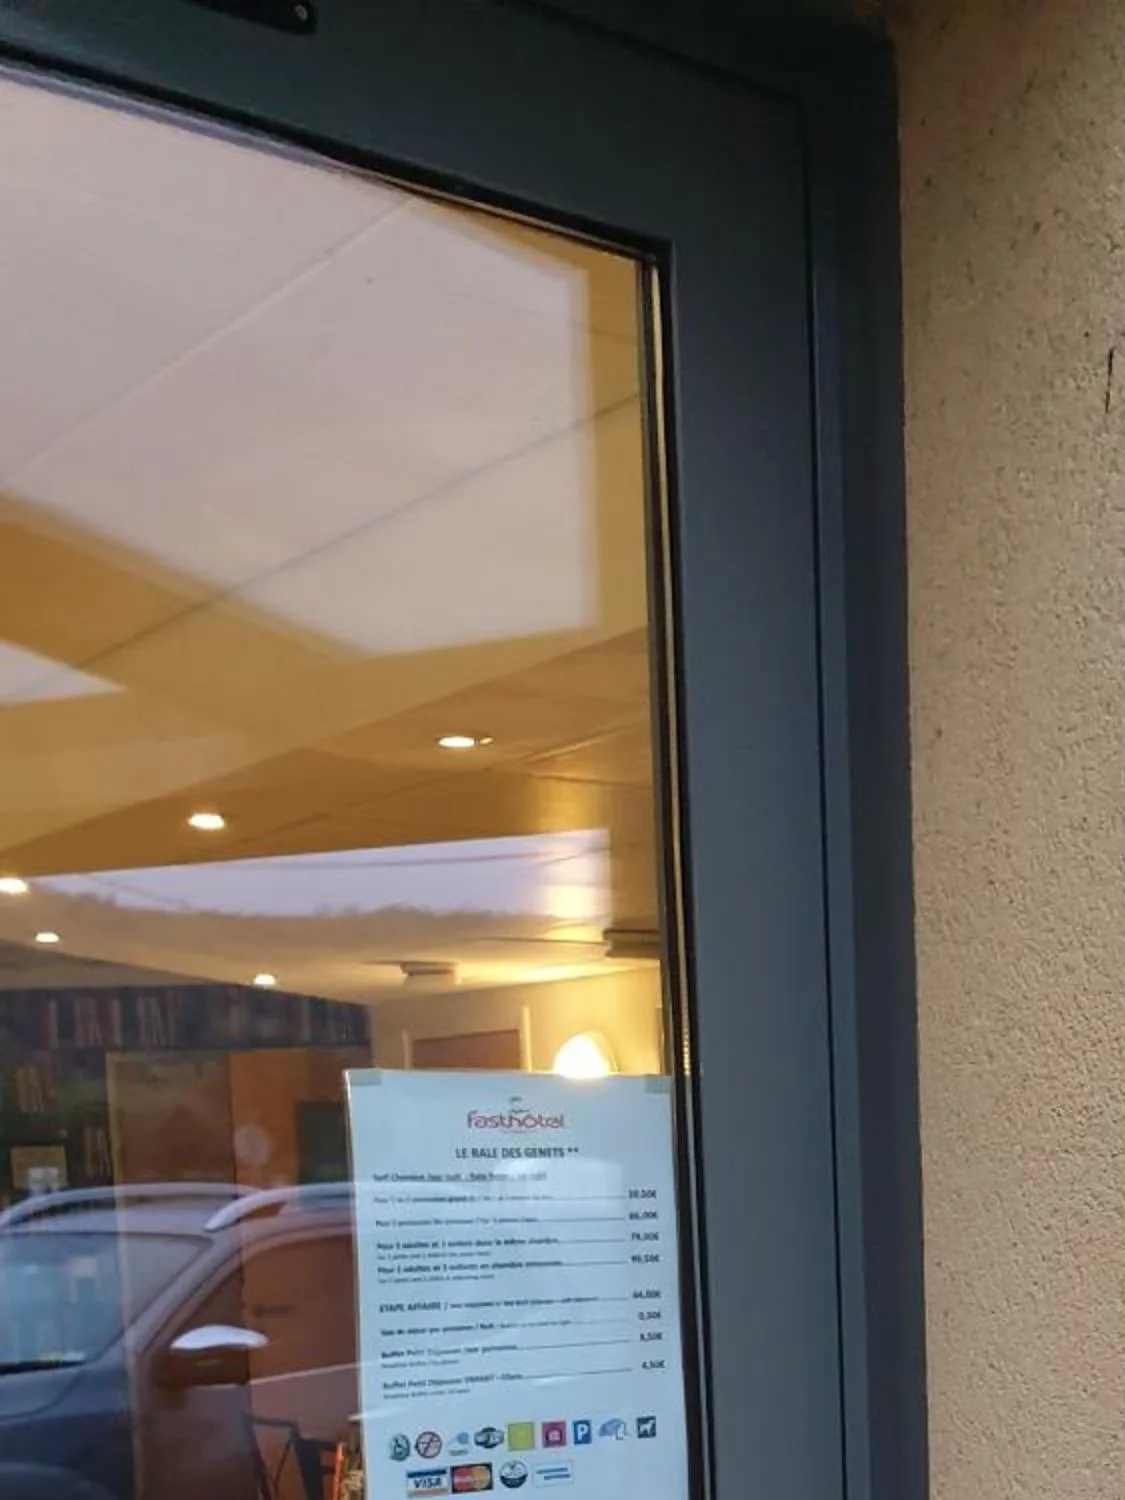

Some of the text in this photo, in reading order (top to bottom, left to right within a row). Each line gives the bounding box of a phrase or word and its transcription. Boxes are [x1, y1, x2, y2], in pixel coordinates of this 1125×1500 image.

[456, 1147, 467, 1158] LE
[501, 1147, 522, 1158] DES
[413, 1477, 442, 1489] VISA
